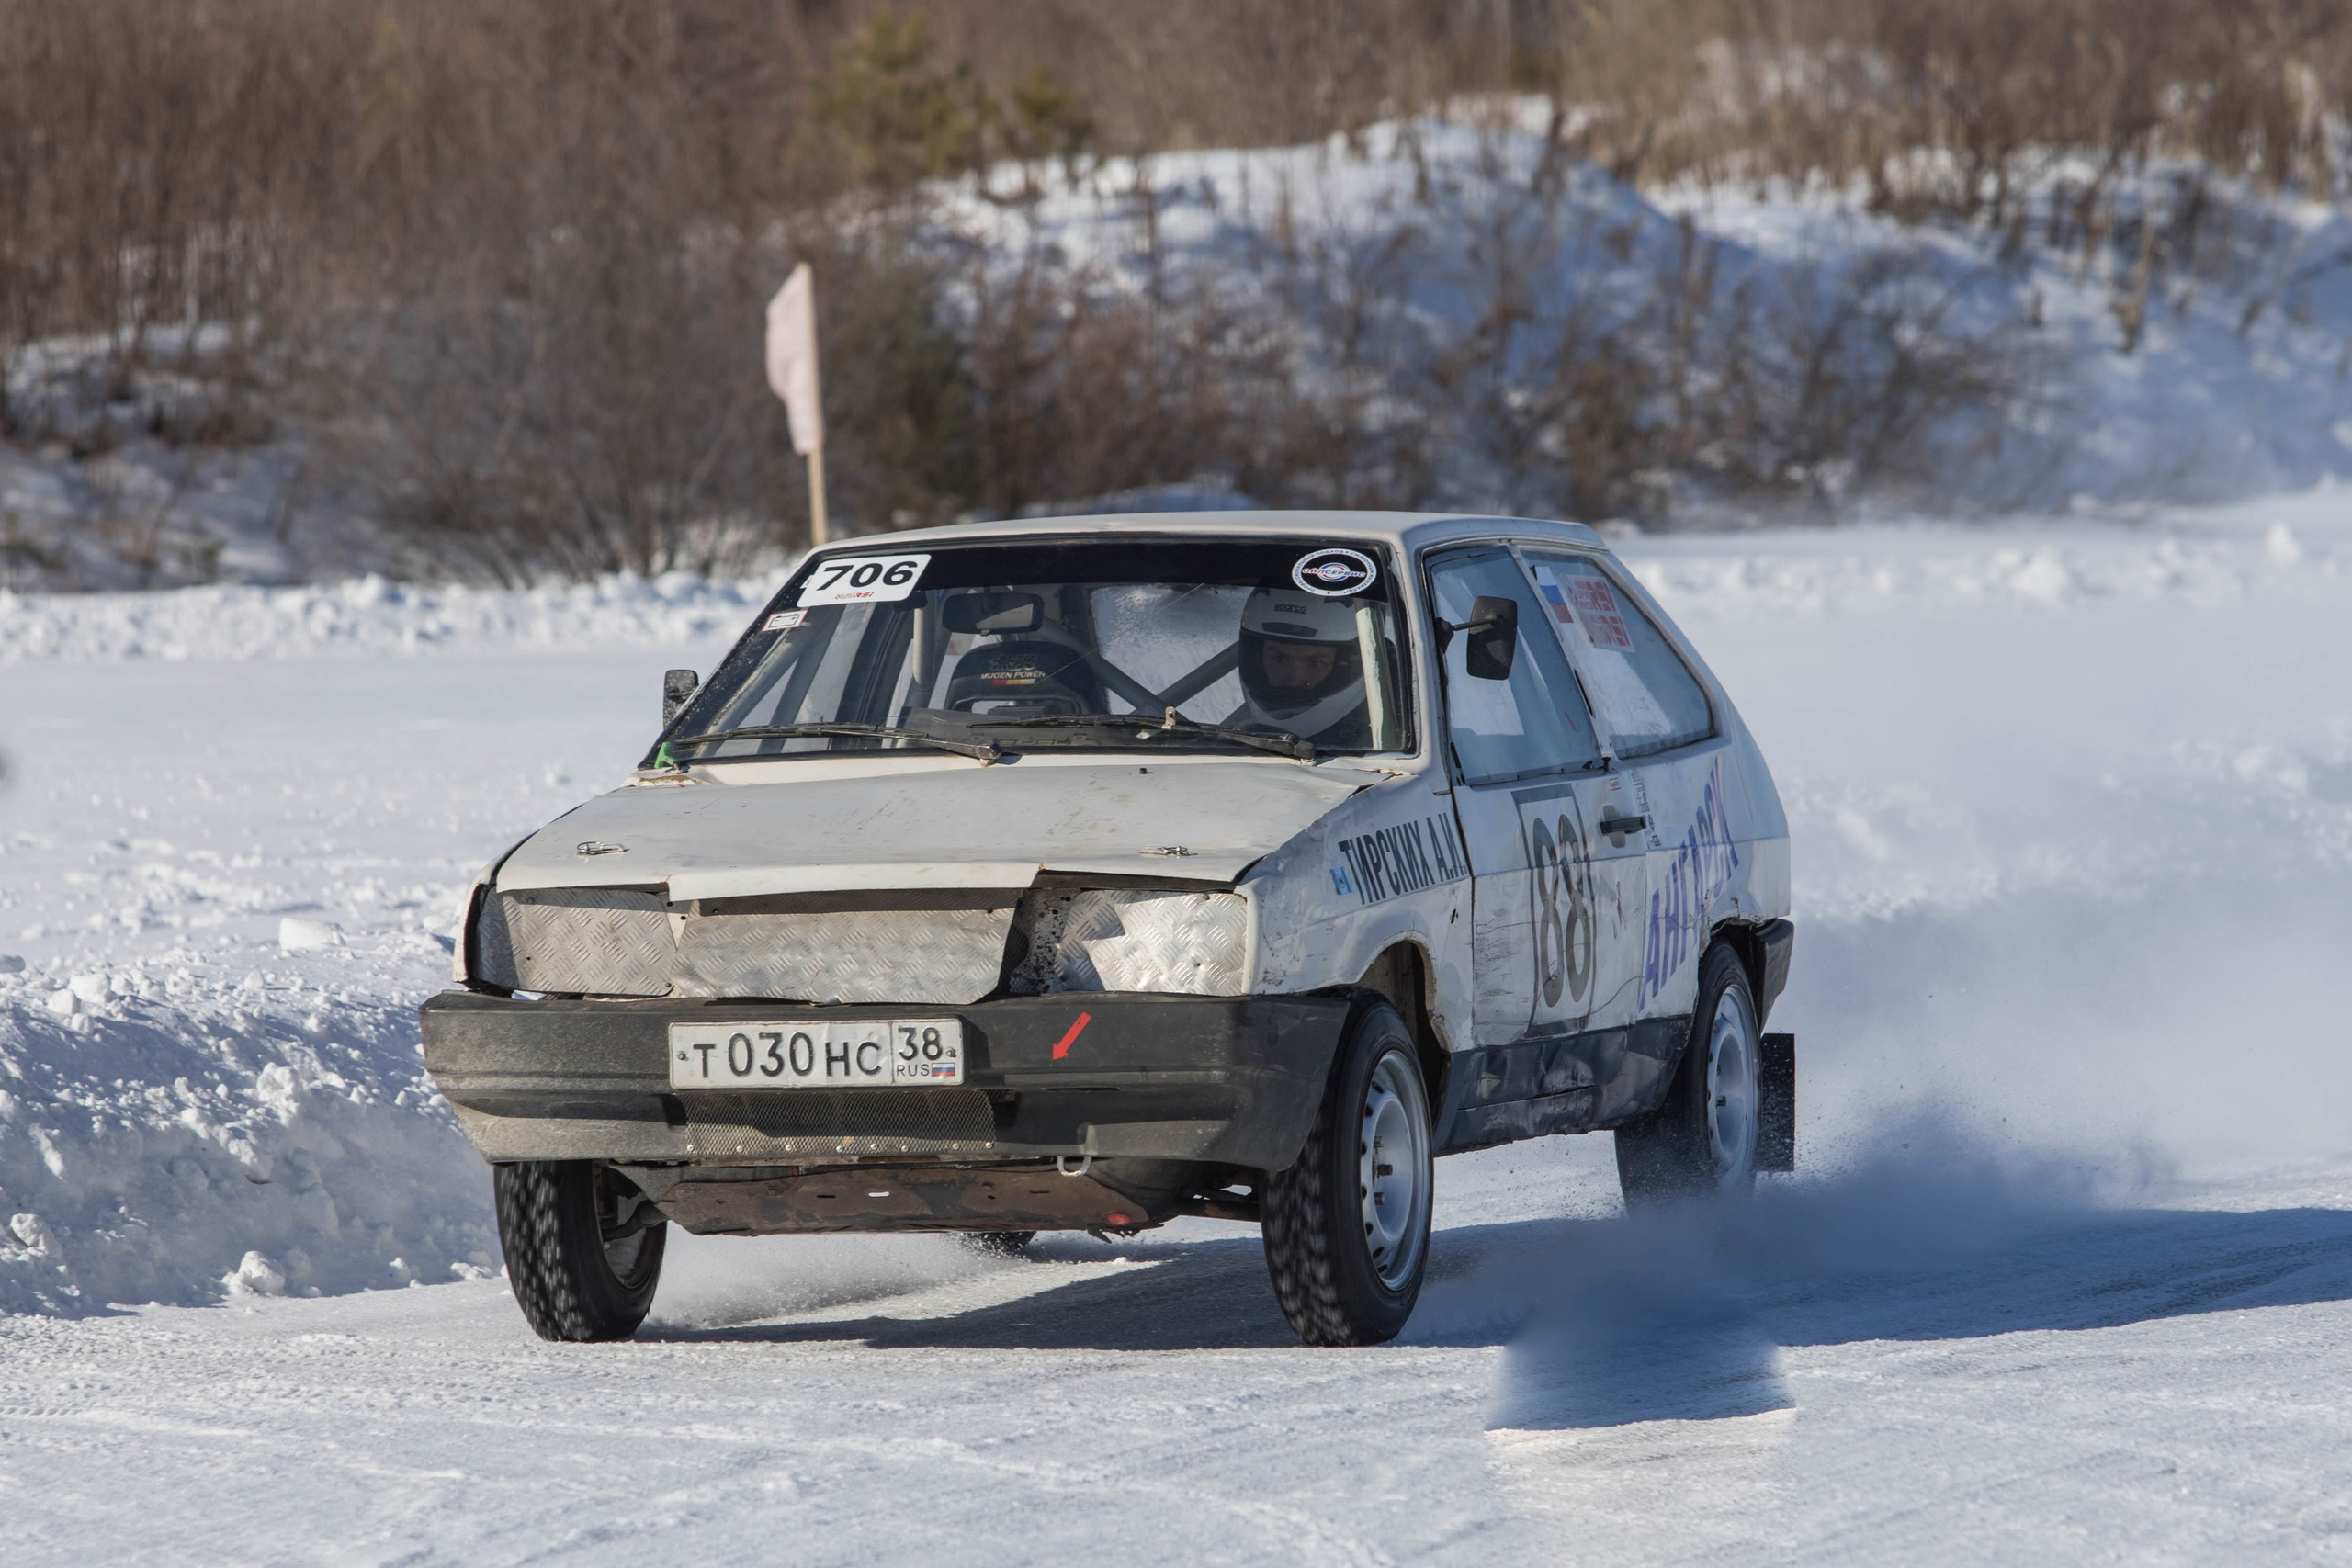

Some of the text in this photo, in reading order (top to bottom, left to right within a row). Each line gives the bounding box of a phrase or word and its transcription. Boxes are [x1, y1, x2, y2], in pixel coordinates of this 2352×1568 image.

[816, 560, 918, 591] 706
[1301, 567, 1366, 579] ОЙЛСЕРВИС
[1338, 820, 1435, 905] ТИРСКИХ
[1532, 813, 1592, 1009] 88
[898, 1027, 944, 1061] 38
[896, 1064, 930, 1077] RUS
